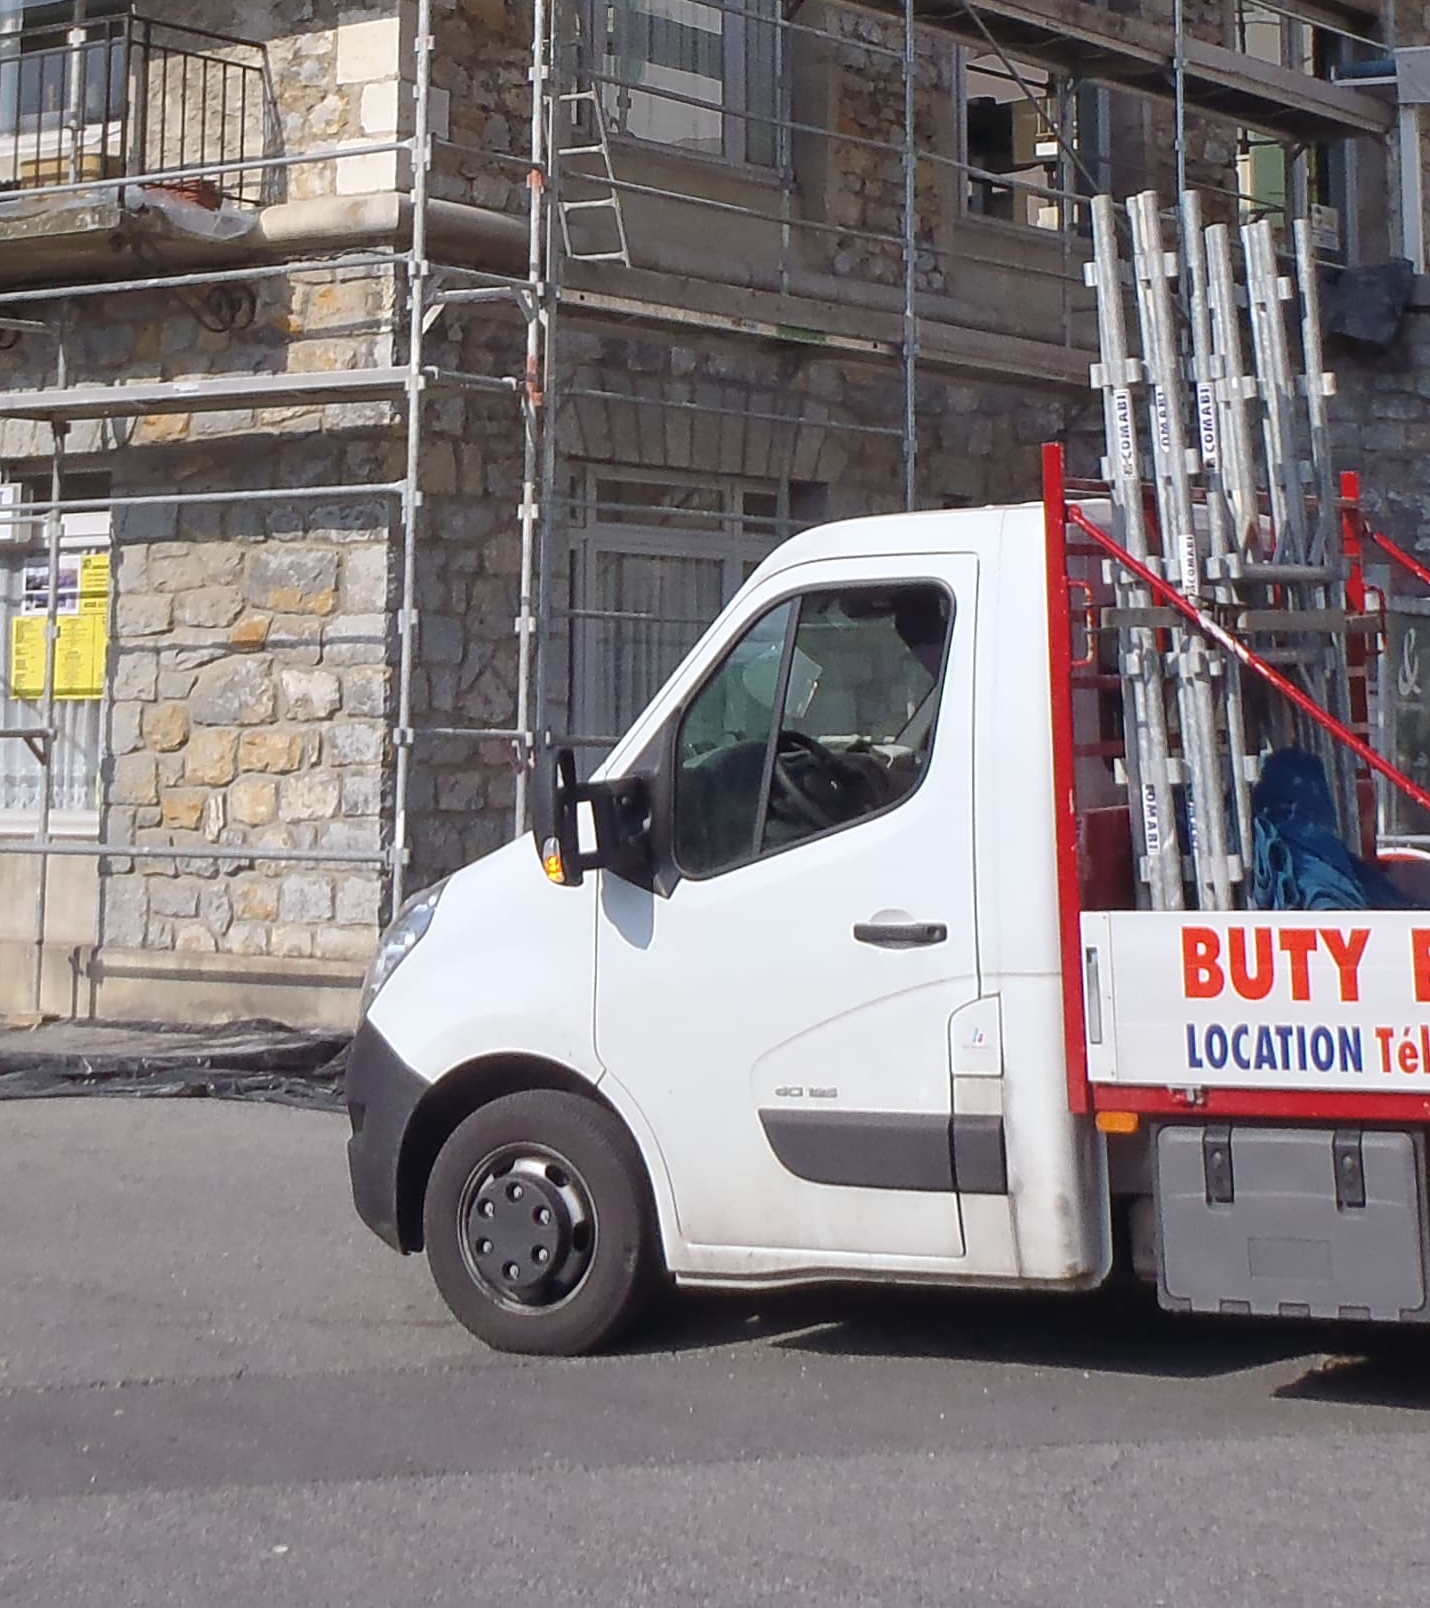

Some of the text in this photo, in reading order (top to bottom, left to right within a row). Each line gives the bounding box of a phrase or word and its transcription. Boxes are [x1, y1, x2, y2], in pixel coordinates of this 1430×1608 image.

[1200, 388, 1215, 453] COMABI
[1182, 926, 1371, 1003] BUTY
[1185, 1024, 1364, 1073] LOCATION
